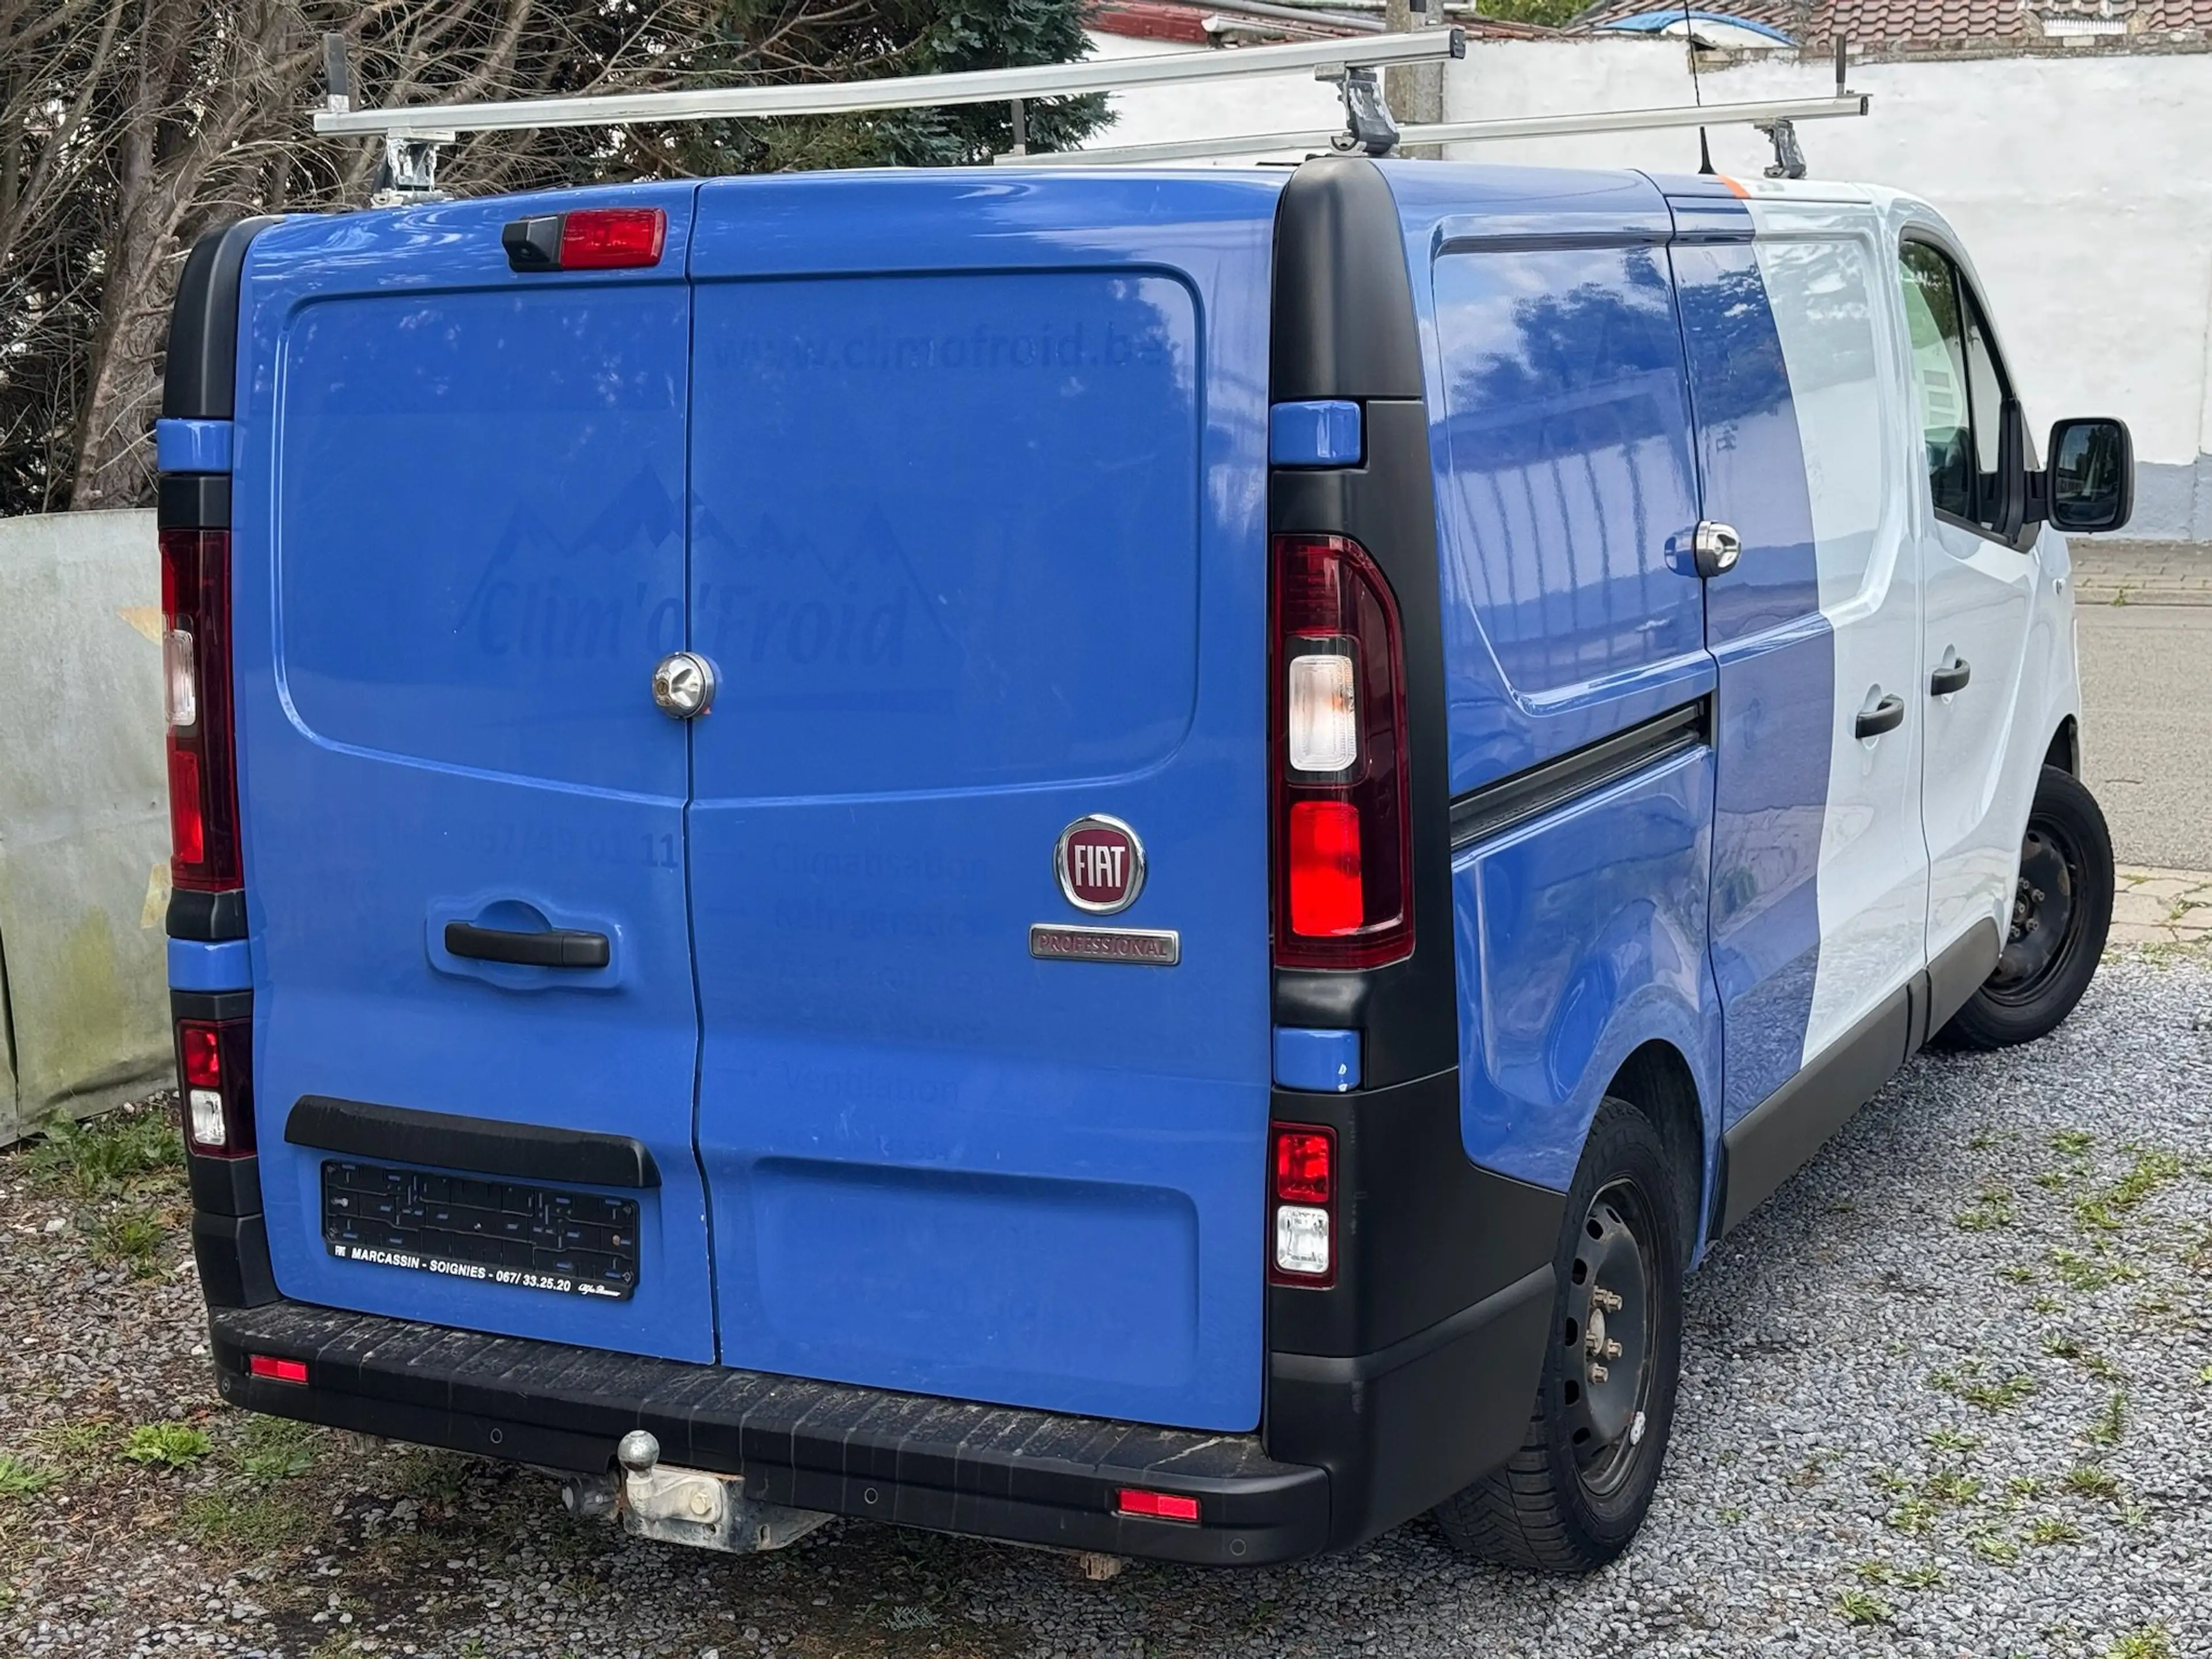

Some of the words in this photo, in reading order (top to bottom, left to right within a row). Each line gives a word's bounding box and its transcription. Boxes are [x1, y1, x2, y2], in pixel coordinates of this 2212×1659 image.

[641, 832, 679, 868] 11
[1074, 844, 1126, 888] FIAT
[1037, 934, 1167, 958] PROFESSIONAL
[351, 1247, 420, 1269] MARCASSIN
[429, 1259, 486, 1279] SOIGNIES
[495, 1270, 521, 1285] 067/
[522, 1274, 571, 1292] 33.25.20
